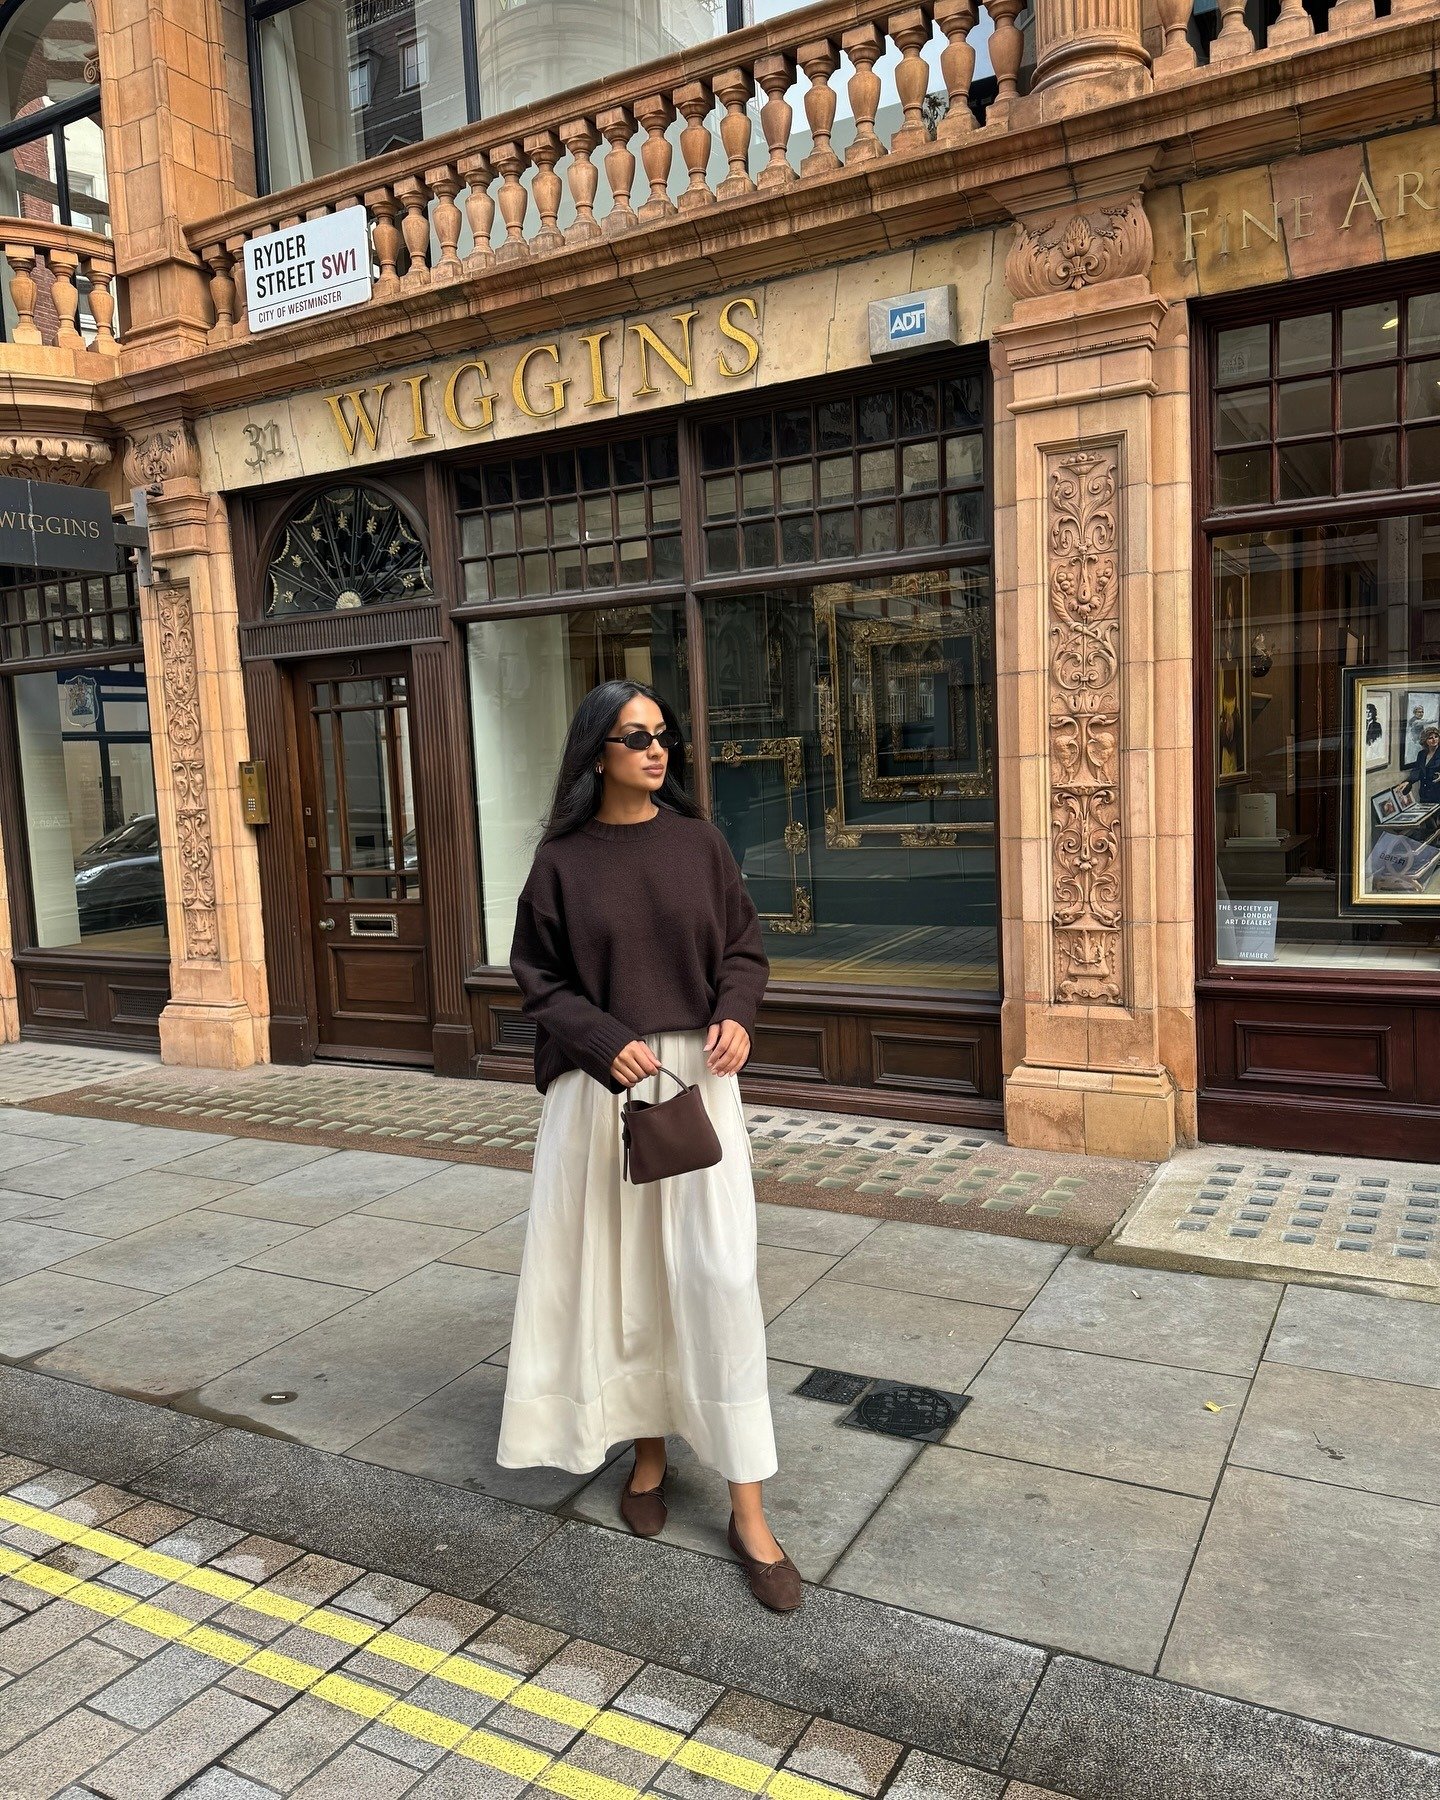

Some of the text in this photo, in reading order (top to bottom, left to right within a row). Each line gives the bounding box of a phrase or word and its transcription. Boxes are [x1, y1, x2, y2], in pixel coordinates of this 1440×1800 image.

[1181, 168, 1440, 262] FINE AR
[254, 234, 307, 270] RYDER
[256, 248, 357, 299] STREET SW1
[258, 290, 342, 323] CITY OF WESTMINSTER
[890, 309, 925, 334] ADT
[242, 298, 760, 467] 31 WIGGINS
